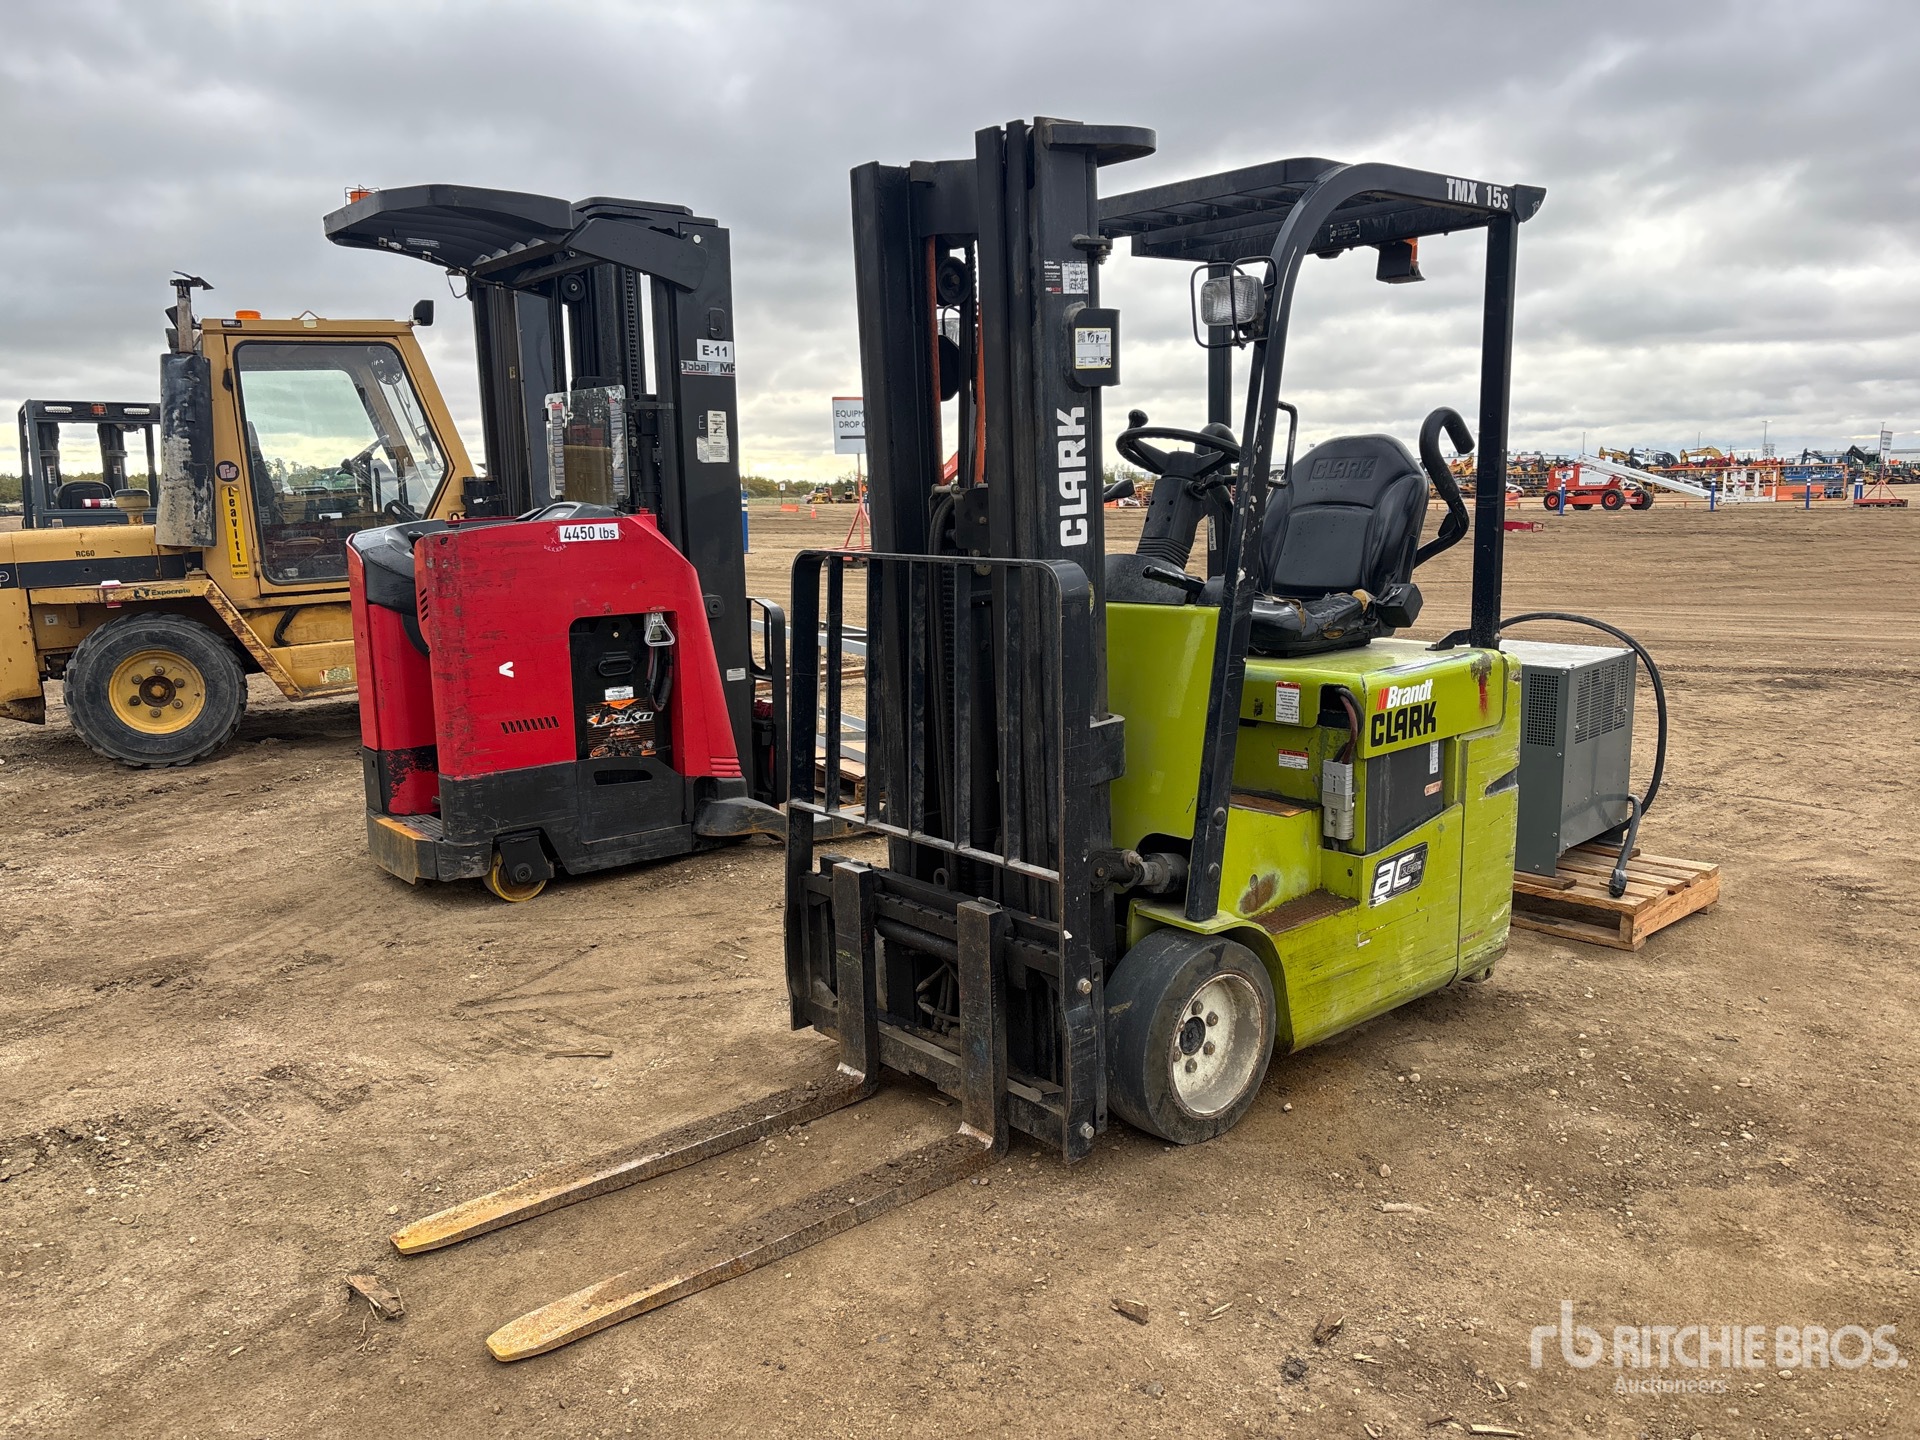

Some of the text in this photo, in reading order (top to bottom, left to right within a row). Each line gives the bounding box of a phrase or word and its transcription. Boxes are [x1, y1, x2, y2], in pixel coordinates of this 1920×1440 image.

[1446, 177, 1478, 205] TMX
[702, 345, 728, 357] E-11
[839, 420, 860, 429] DROP
[1056, 406, 1088, 547] CLARK
[1312, 459, 1375, 480] CLARK
[227, 486, 242, 562] Leavitt
[564, 526, 616, 541] 4450 lbs
[75, 549, 95, 558] RC60
[1386, 678, 1434, 709] Brandt
[1370, 700, 1437, 748] CLARK
